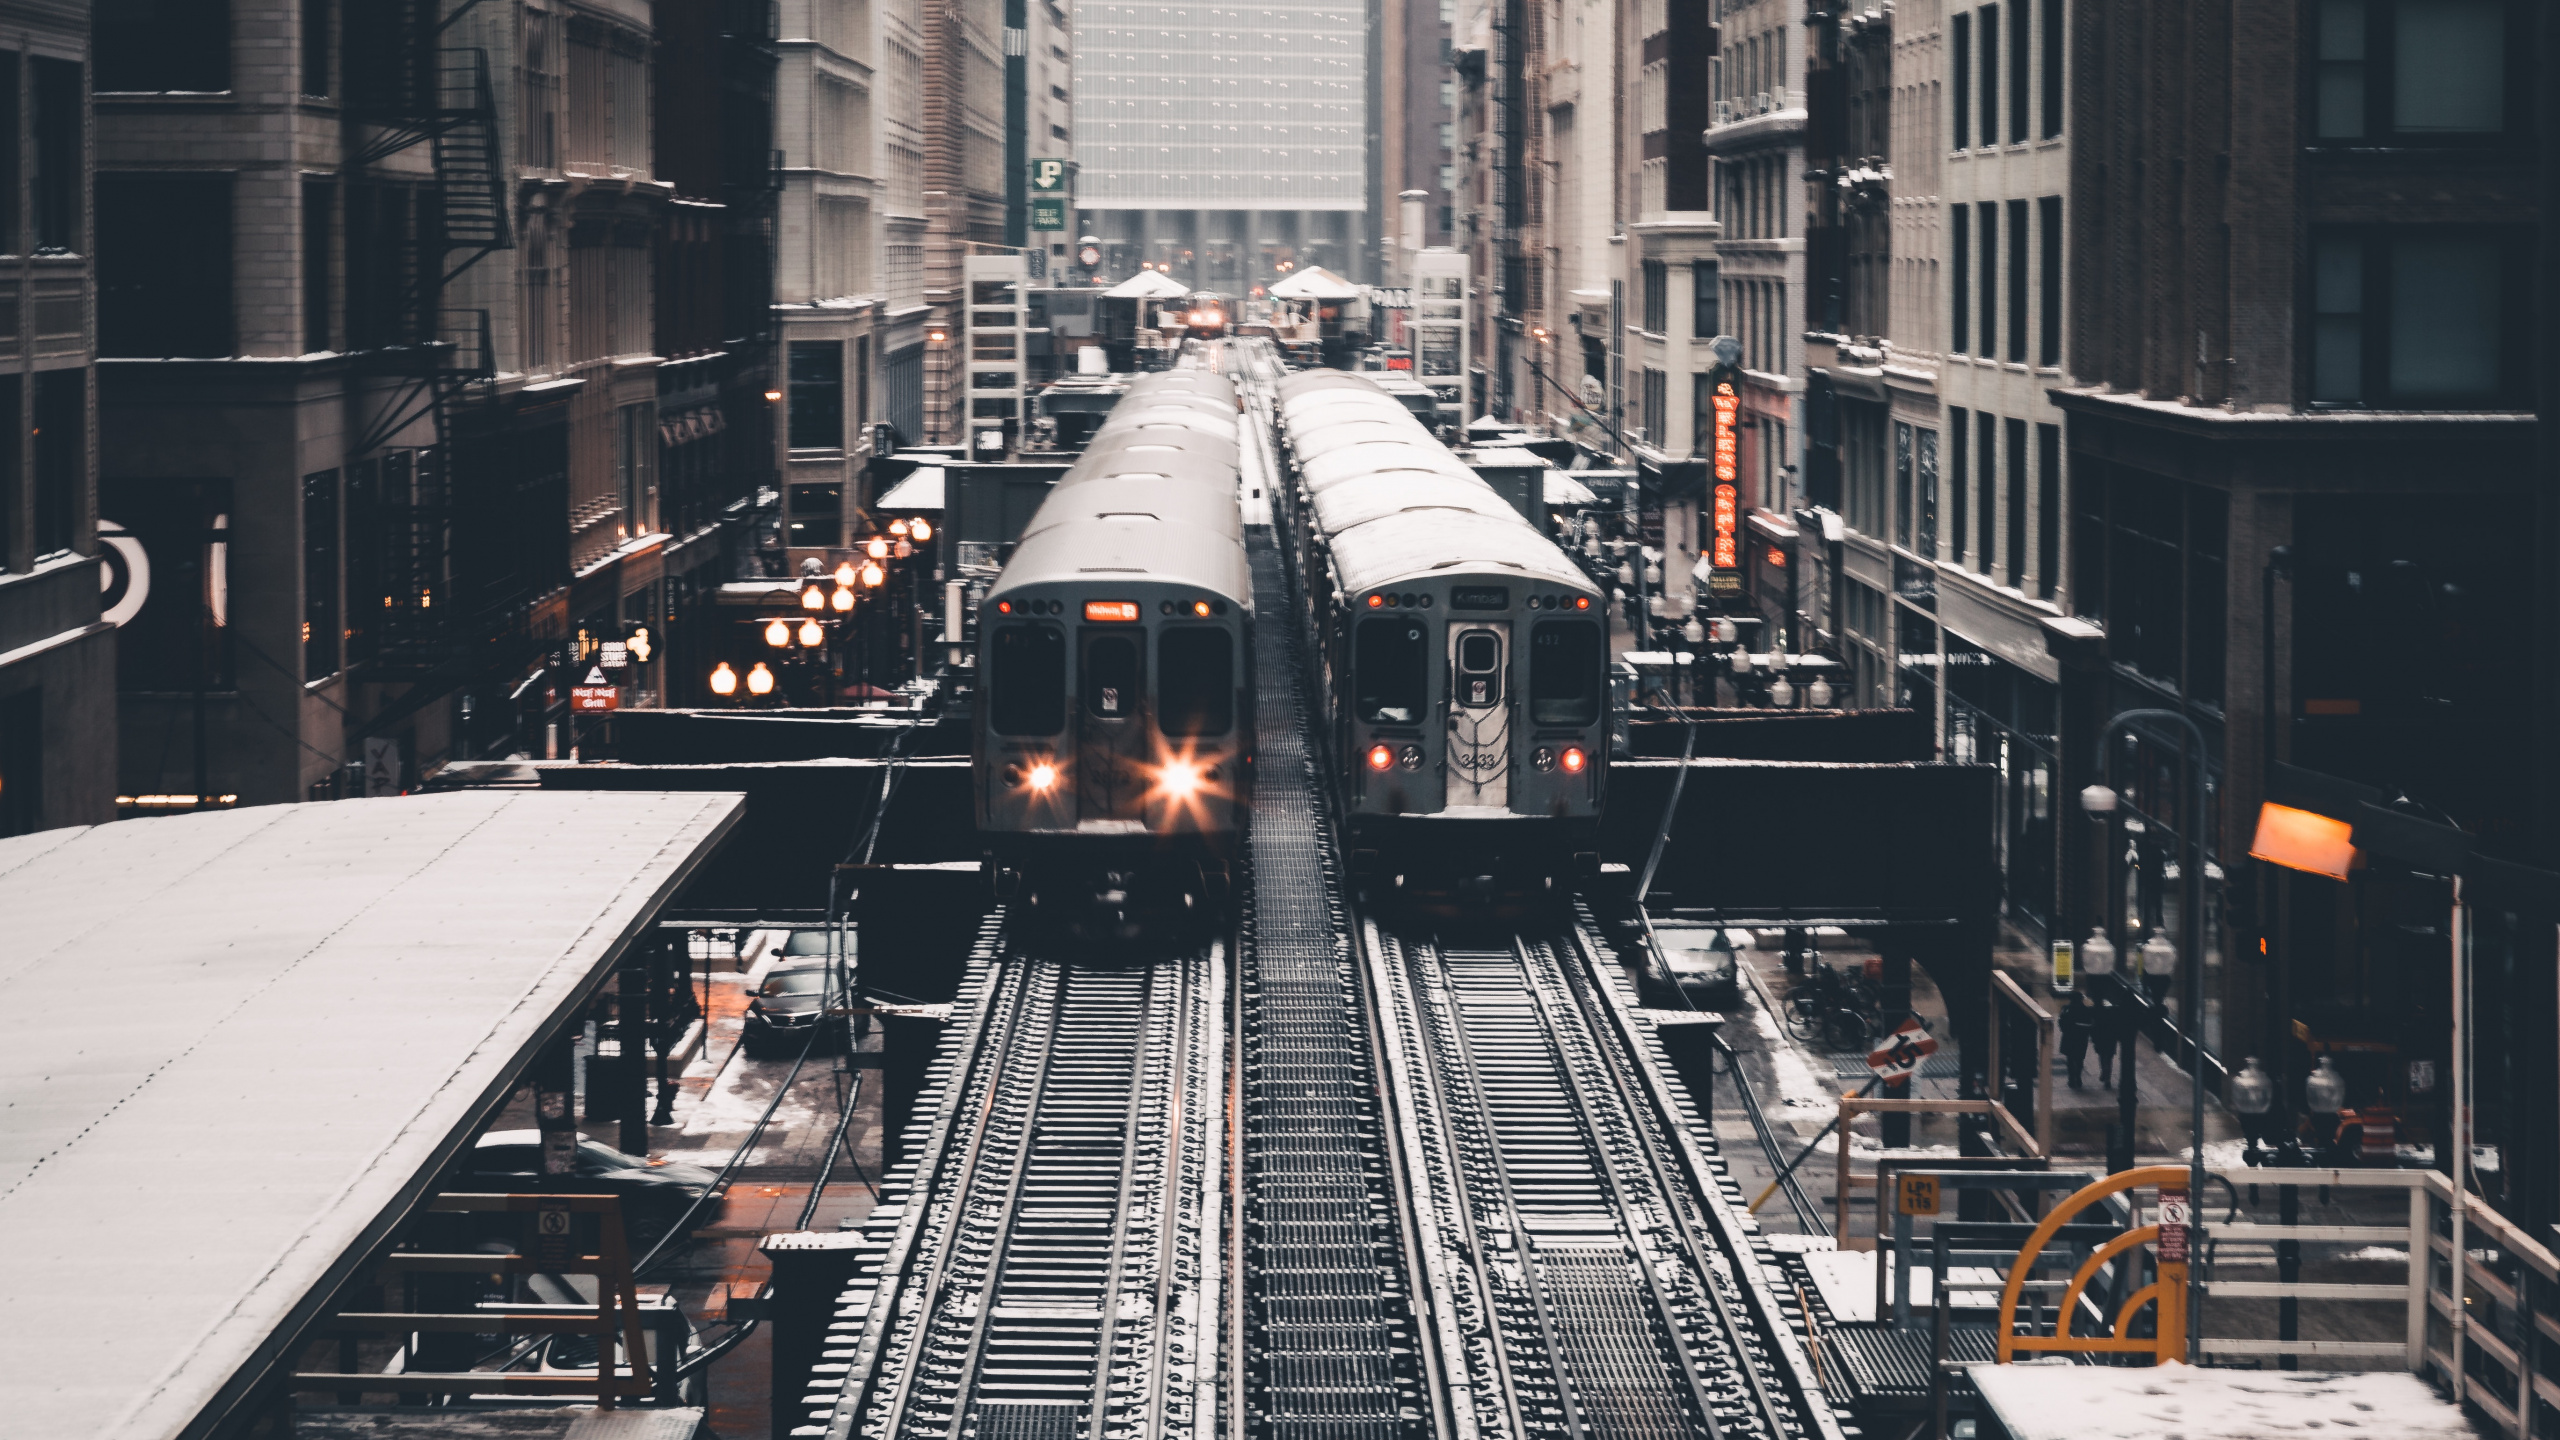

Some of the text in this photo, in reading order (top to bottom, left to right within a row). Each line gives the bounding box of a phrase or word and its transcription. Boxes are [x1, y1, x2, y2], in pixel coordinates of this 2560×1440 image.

[1035, 216, 1061, 225] PARK
[1456, 591, 1504, 605] Kimball
[601, 641, 627, 652] GOOD
[600, 652, 628, 661] STUFF
[572, 687, 617, 698] Naf Naf
[582, 698, 607, 708] Grill
[1461, 753, 1495, 770] 3433
[1887, 1033, 1924, 1069] 15
